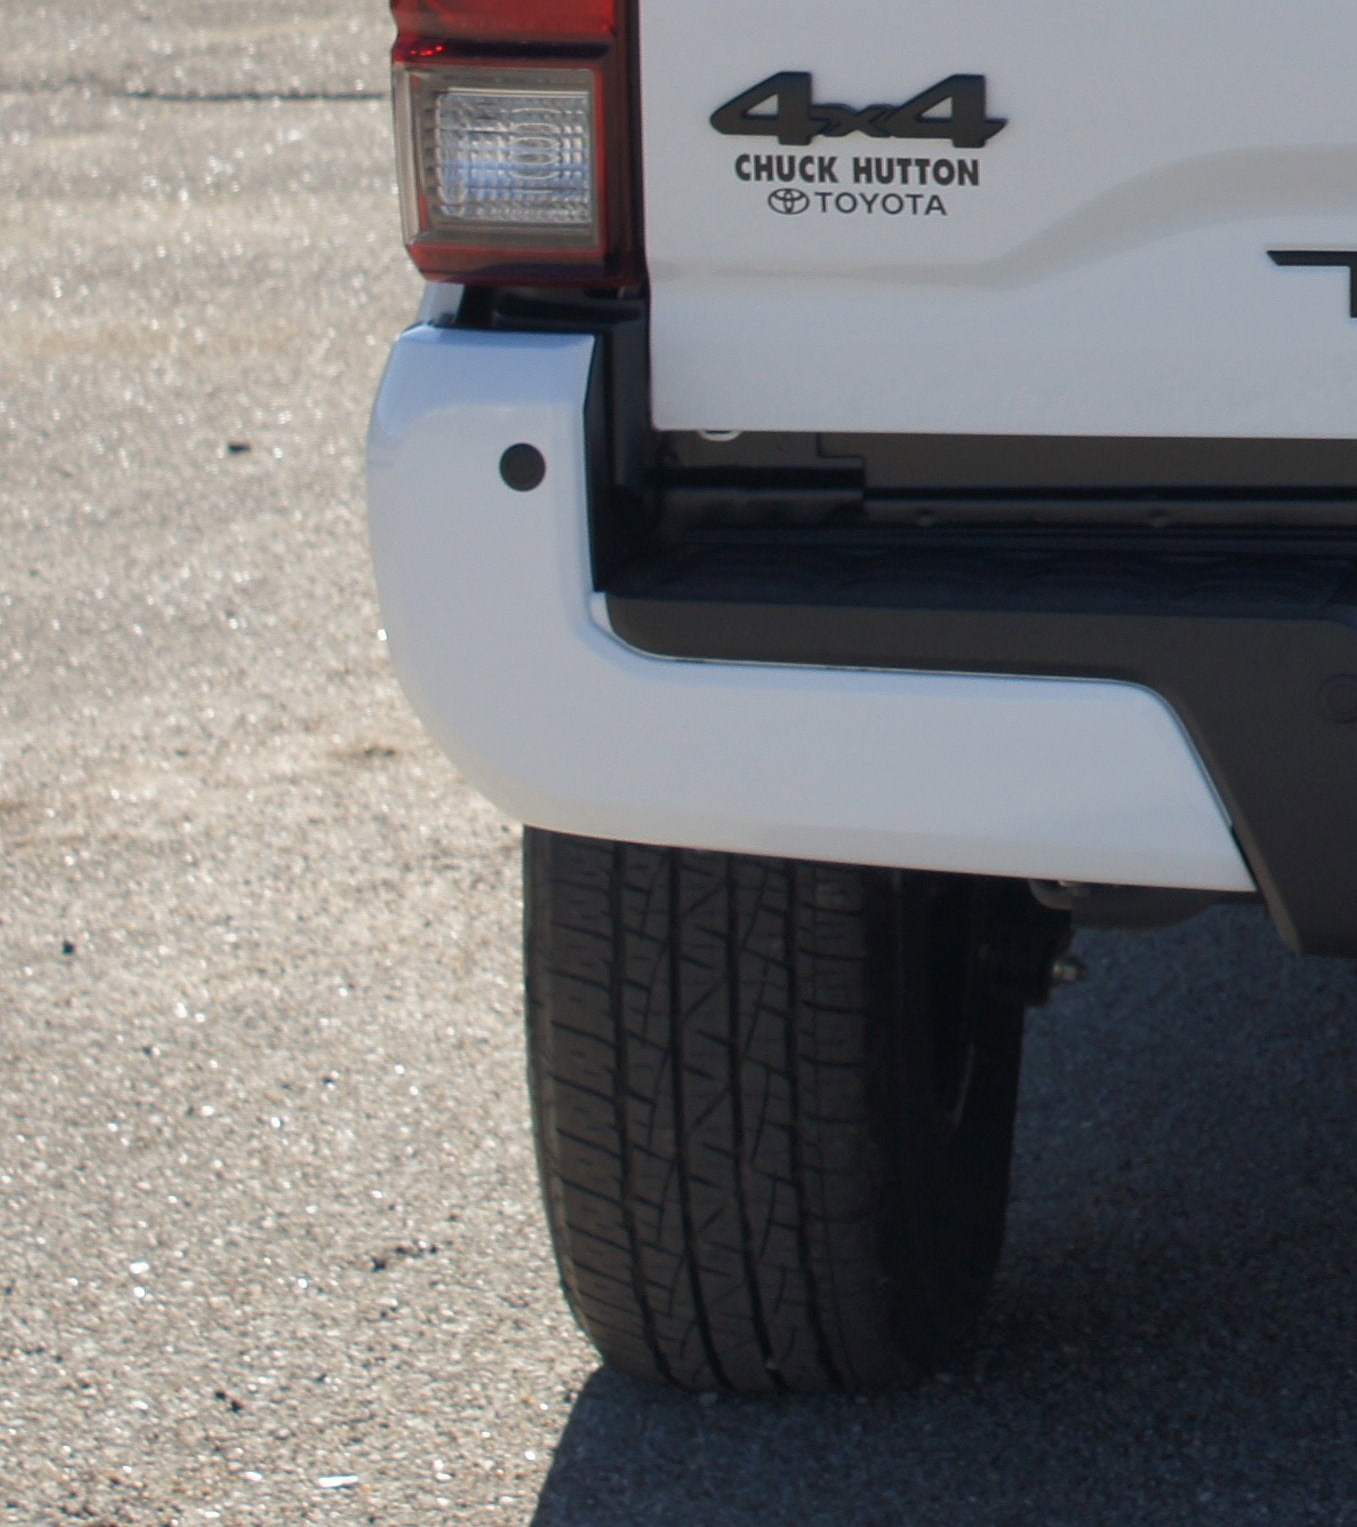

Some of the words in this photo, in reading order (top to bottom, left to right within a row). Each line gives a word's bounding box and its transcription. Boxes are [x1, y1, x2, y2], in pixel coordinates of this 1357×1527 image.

[734, 153, 838, 183] CHUCK
[853, 157, 979, 186] HUTTON
[814, 191, 948, 216] TOYOTA
